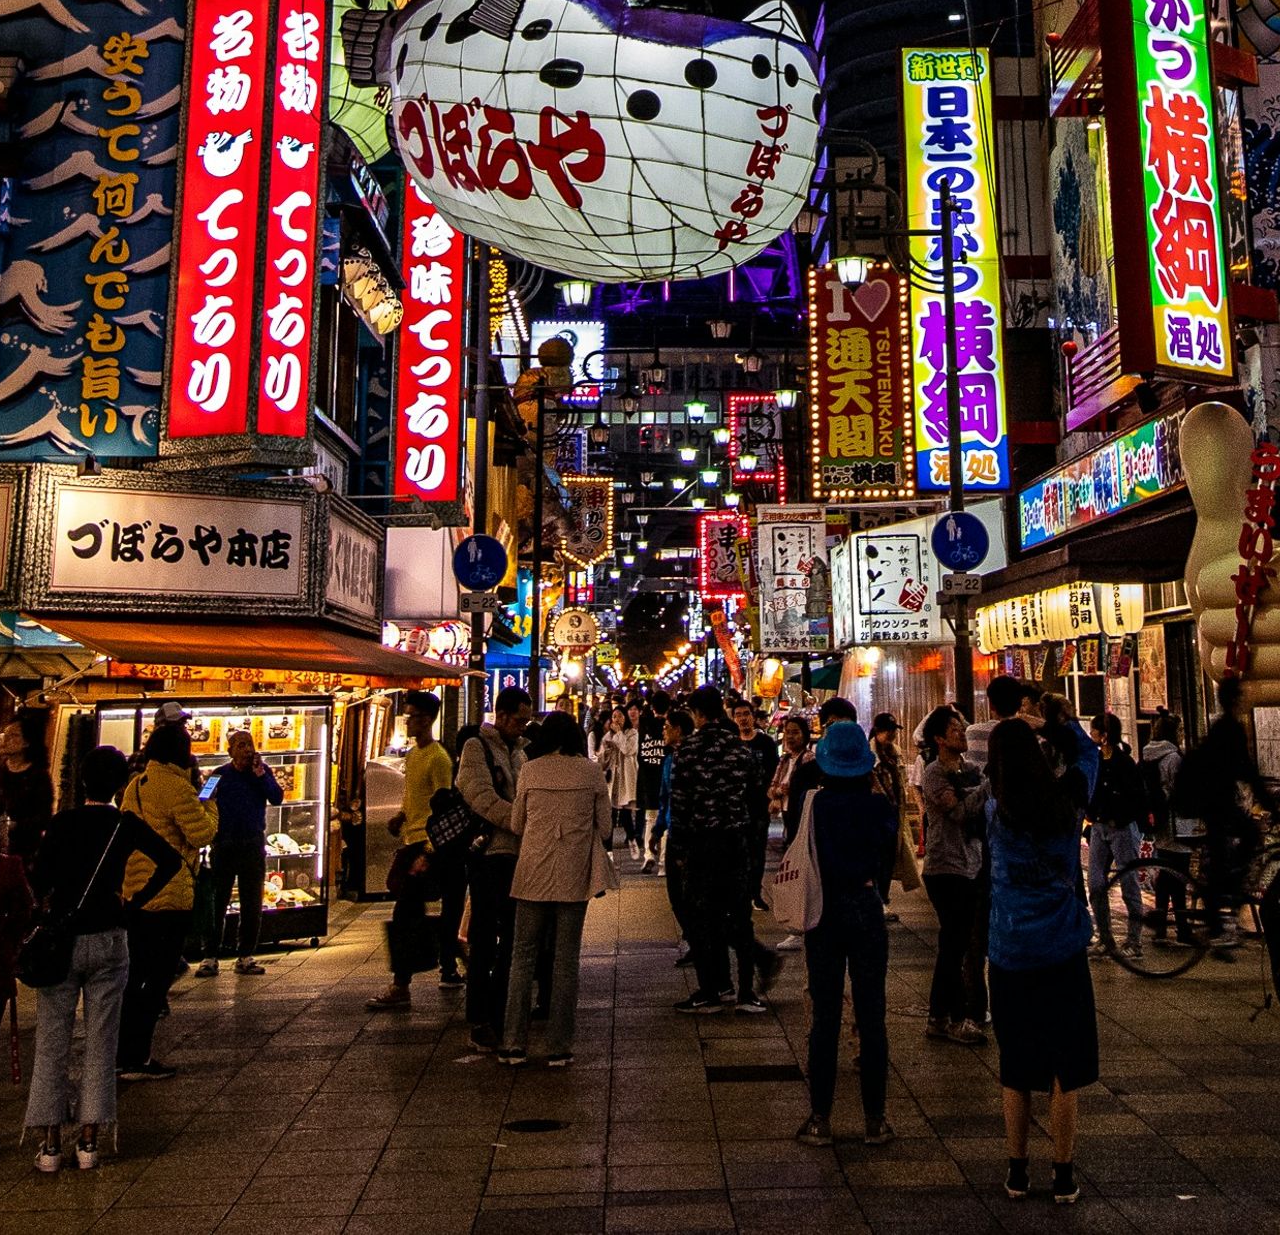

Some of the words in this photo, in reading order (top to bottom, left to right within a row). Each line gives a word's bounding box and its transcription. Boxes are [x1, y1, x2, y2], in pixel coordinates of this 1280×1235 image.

[208, 8, 253, 114] 名物
[279, 8, 320, 113] 名物
[909, 52, 984, 82] 新世界
[397, 95, 606, 209] づぼらや
[714, 103, 794, 250] づぼらや
[925, 87, 977, 295] 日本一の串かつ
[1144, 86, 1221, 310] 横綱
[405, 176, 454, 492] 珍味てっちり
[825, 281, 851, 321] I
[1167, 314, 1221, 365] 酒処
[826, 327, 873, 457] 通天閣
[876, 327, 894, 456] TSUTENKAKU
[918, 300, 999, 445] 横綱
[930, 448, 999, 485] 酒処
[67, 518, 293, 570] づぼらや本店
[463, 597, 495, 608] 9-22
[1080, 592, 1092, 624] 寿司
[641, 740, 665, 750] SOCIAL
[641, 749, 665, 757] SOCIAL
